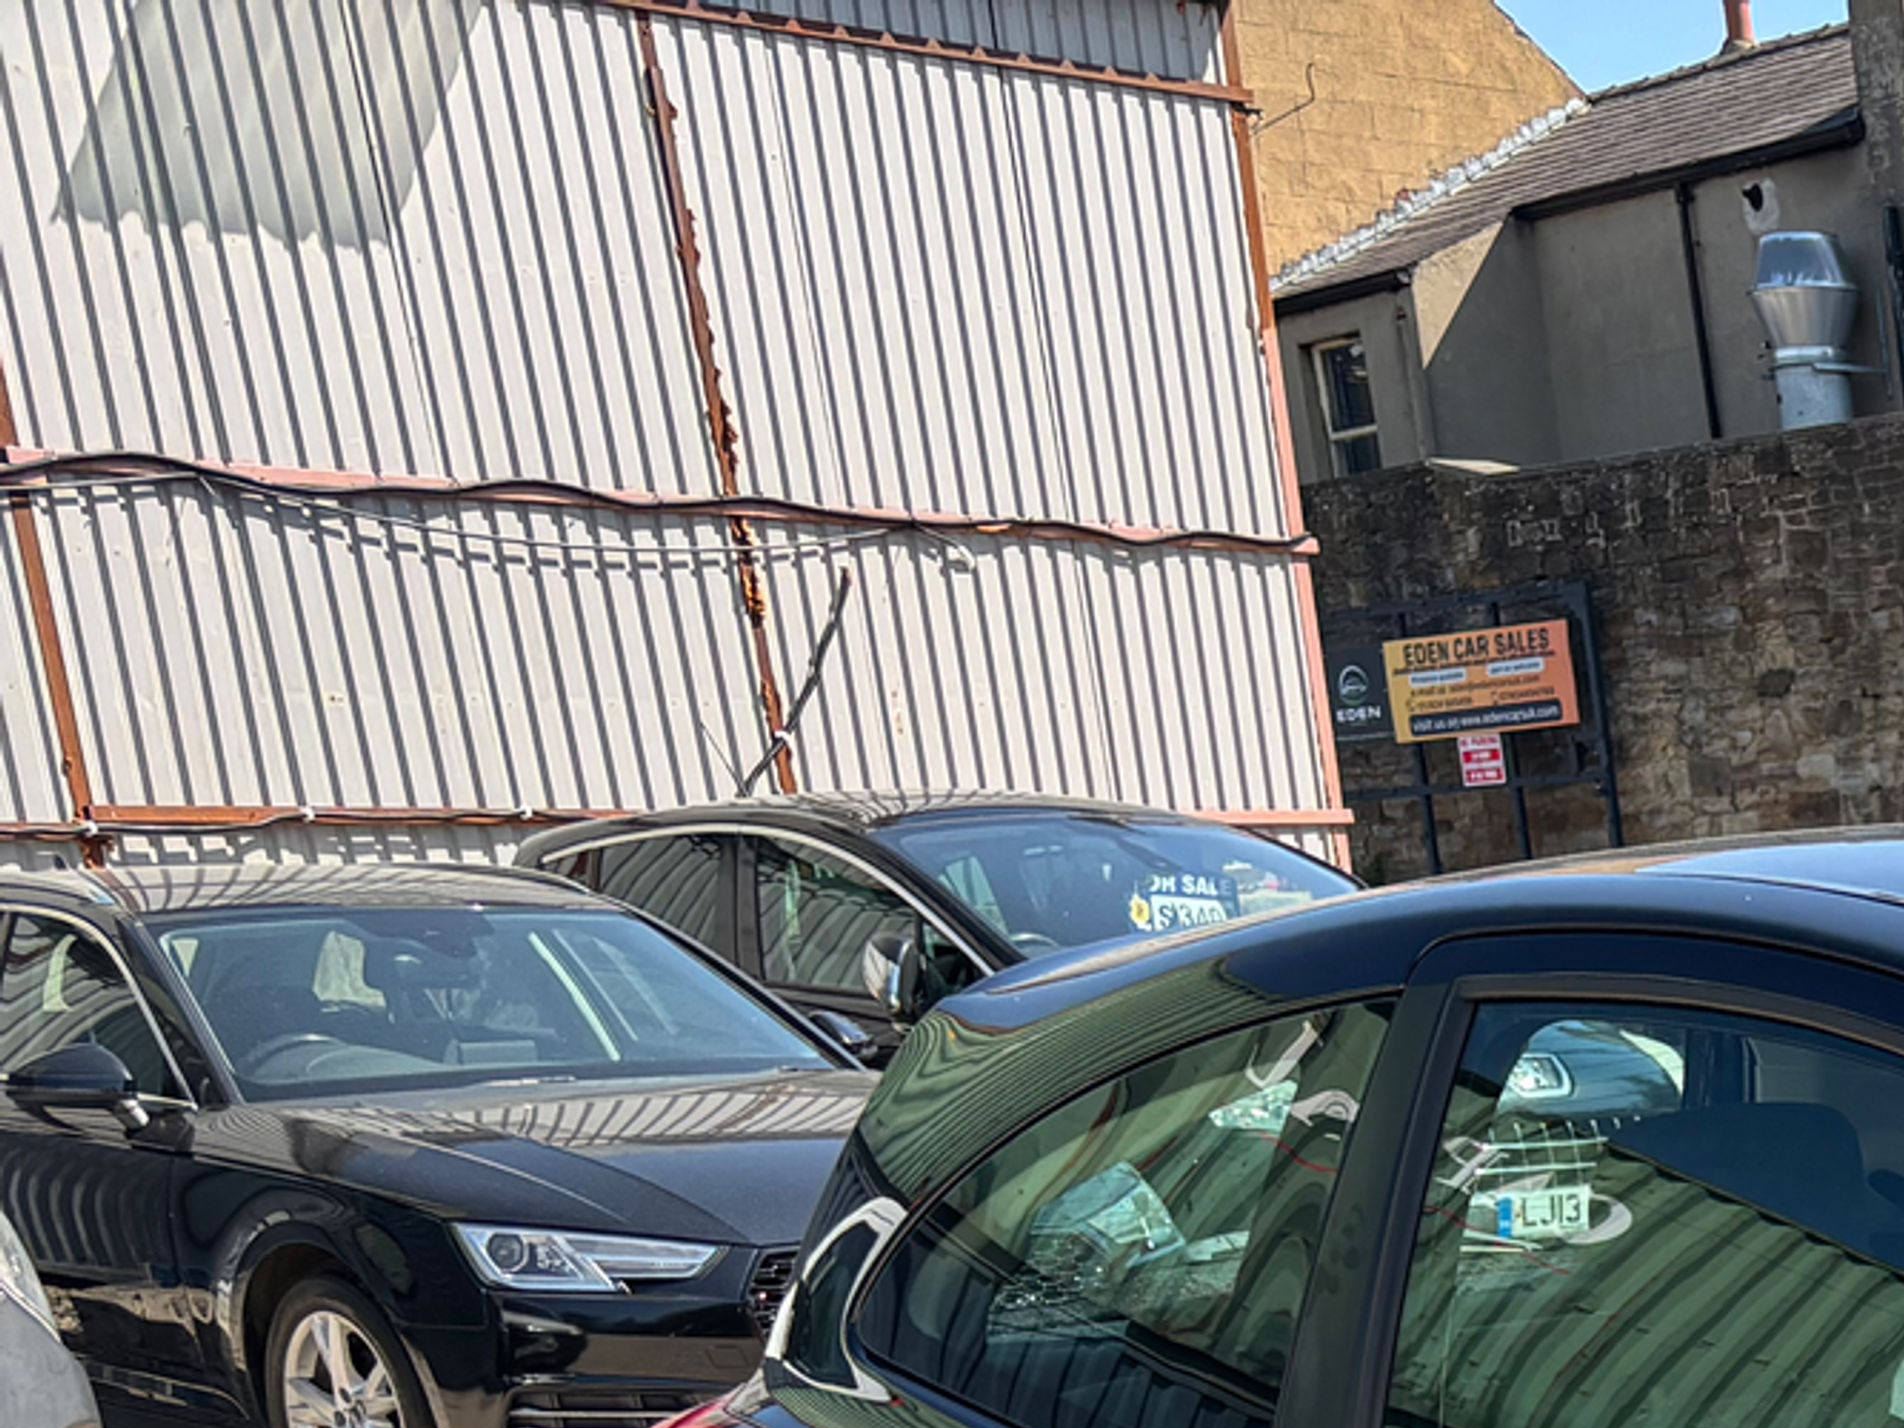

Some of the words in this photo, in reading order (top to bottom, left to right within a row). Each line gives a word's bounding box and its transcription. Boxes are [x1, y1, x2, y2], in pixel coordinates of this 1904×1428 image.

[1403, 641, 1449, 666] EDEN
[1454, 634, 1489, 660] CAR
[1494, 628, 1549, 655] SALES
[1520, 1193, 1581, 1227] LJ13
